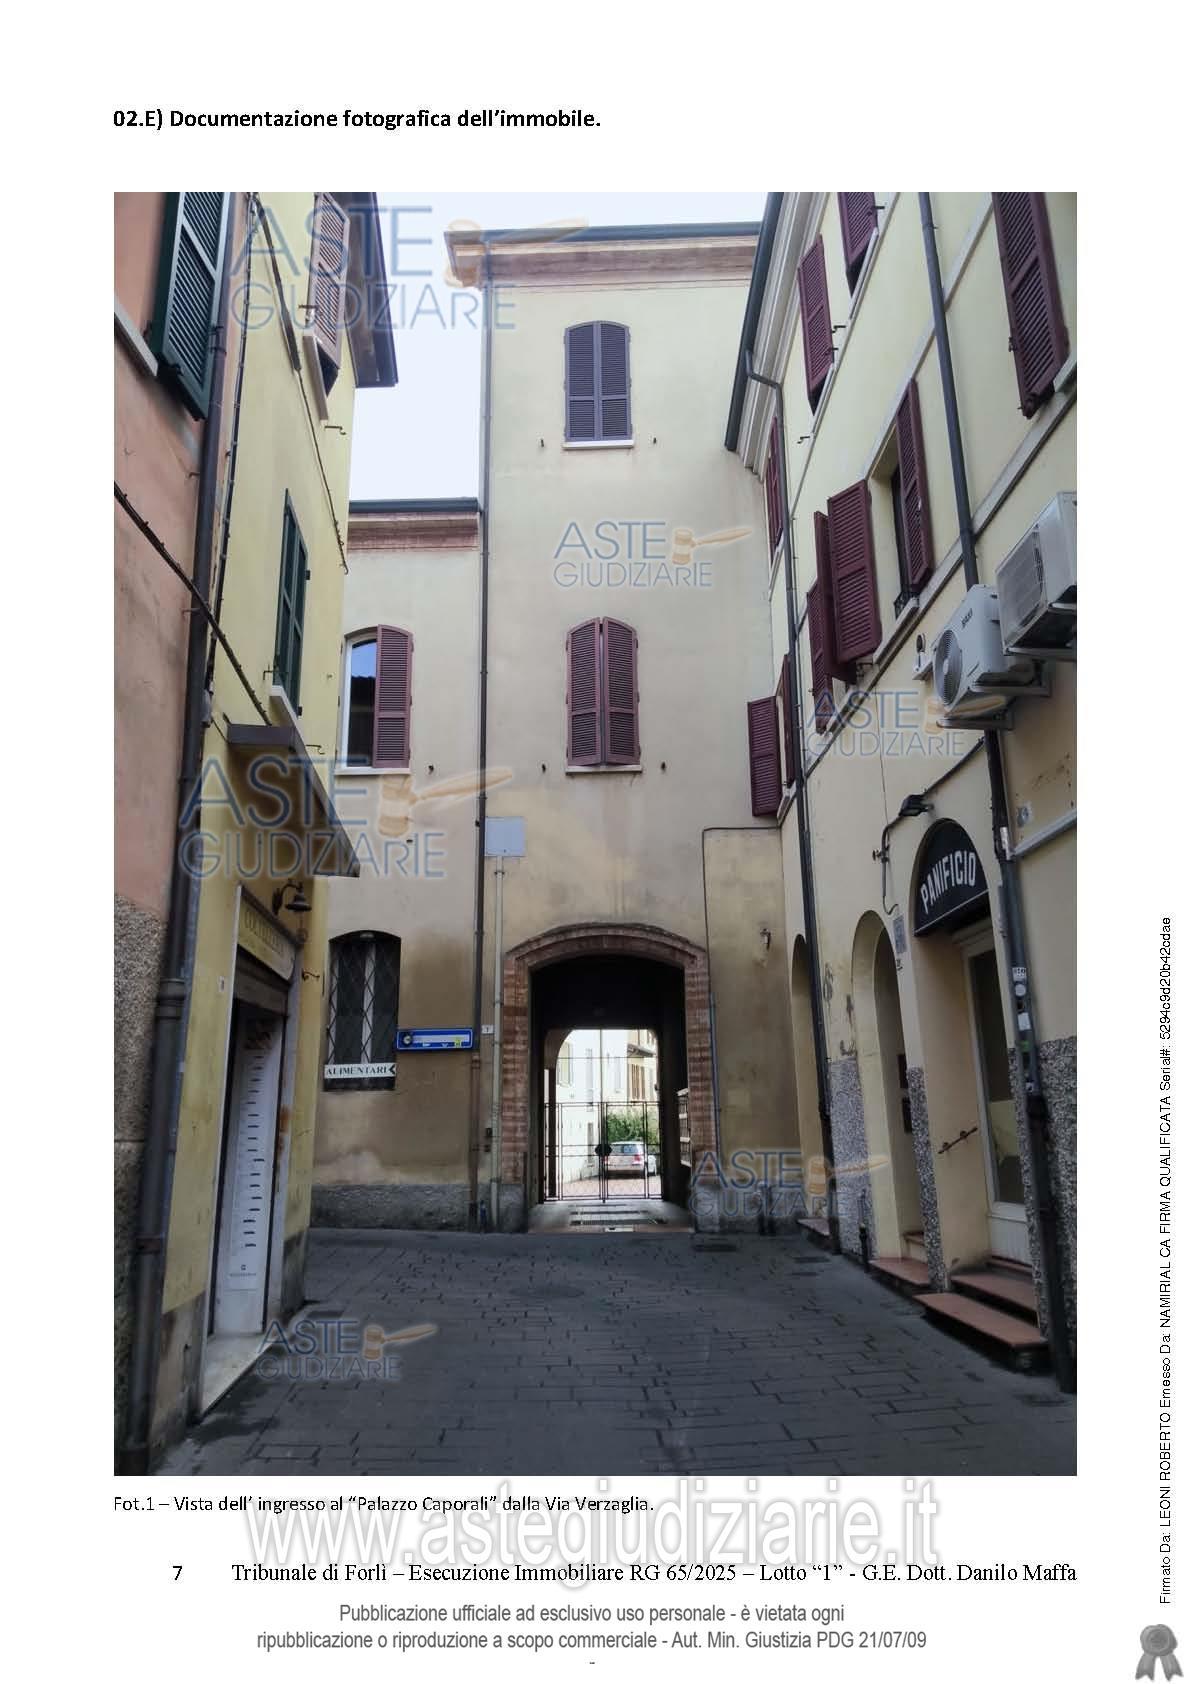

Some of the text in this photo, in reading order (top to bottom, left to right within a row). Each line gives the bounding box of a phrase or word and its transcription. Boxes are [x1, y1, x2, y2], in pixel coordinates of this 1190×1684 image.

[113, 108, 601, 131] 02.E) Documentazione fotografica dell’immobile.
[920, 850, 976, 915] PANIFICIO
[1159, 917, 1171, 1040] 5294c9d20b42cdae
[327, 1065, 388, 1075] ALIMENTARI
[1159, 1095, 1171, 1187] QUALIFICATA
[1159, 1190, 1171, 1234] FIRMA
[1159, 1238, 1171, 1258] CA
[1159, 1261, 1171, 1328] NAMIRIAL
[1159, 1357, 1171, 1408] Emesso
[1159, 1412, 1171, 1481] ROBERTO
[114, 1496, 155, 1511] Fot.1
[173, 1496, 213, 1511] Vista
[258, 1496, 326, 1515] ingresso
[330, 1495, 343, 1511] al
[348, 1495, 418, 1511] “Palazzo
[422, 1495, 497, 1515] Caporali”
[502, 1495, 540, 1511] dalla
[544, 1496, 570, 1511] Via
[574, 1495, 654, 1515] Verzaglia.
[1159, 1486, 1171, 1527] LEONI
[172, 1565, 183, 1581] 7
[231, 1563, 317, 1581] Tribunale
[322, 1563, 339, 1581] di
[344, 1563, 387, 1581] Forlì
[408, 1563, 510, 1581] Esecuzione
[514, 1563, 624, 1581] Immobiliare
[629, 1564, 661, 1581] RG
[666, 1563, 736, 1581] 65/2025
[759, 1564, 807, 1581] Lotto
[862, 1564, 901, 1581] G.E.
[906, 1564, 952, 1581] Dott.
[956, 1563, 1018, 1581] Danilo
[1022, 1563, 1078, 1581] Maffa
[1159, 1556, 1171, 1604] Firmato
